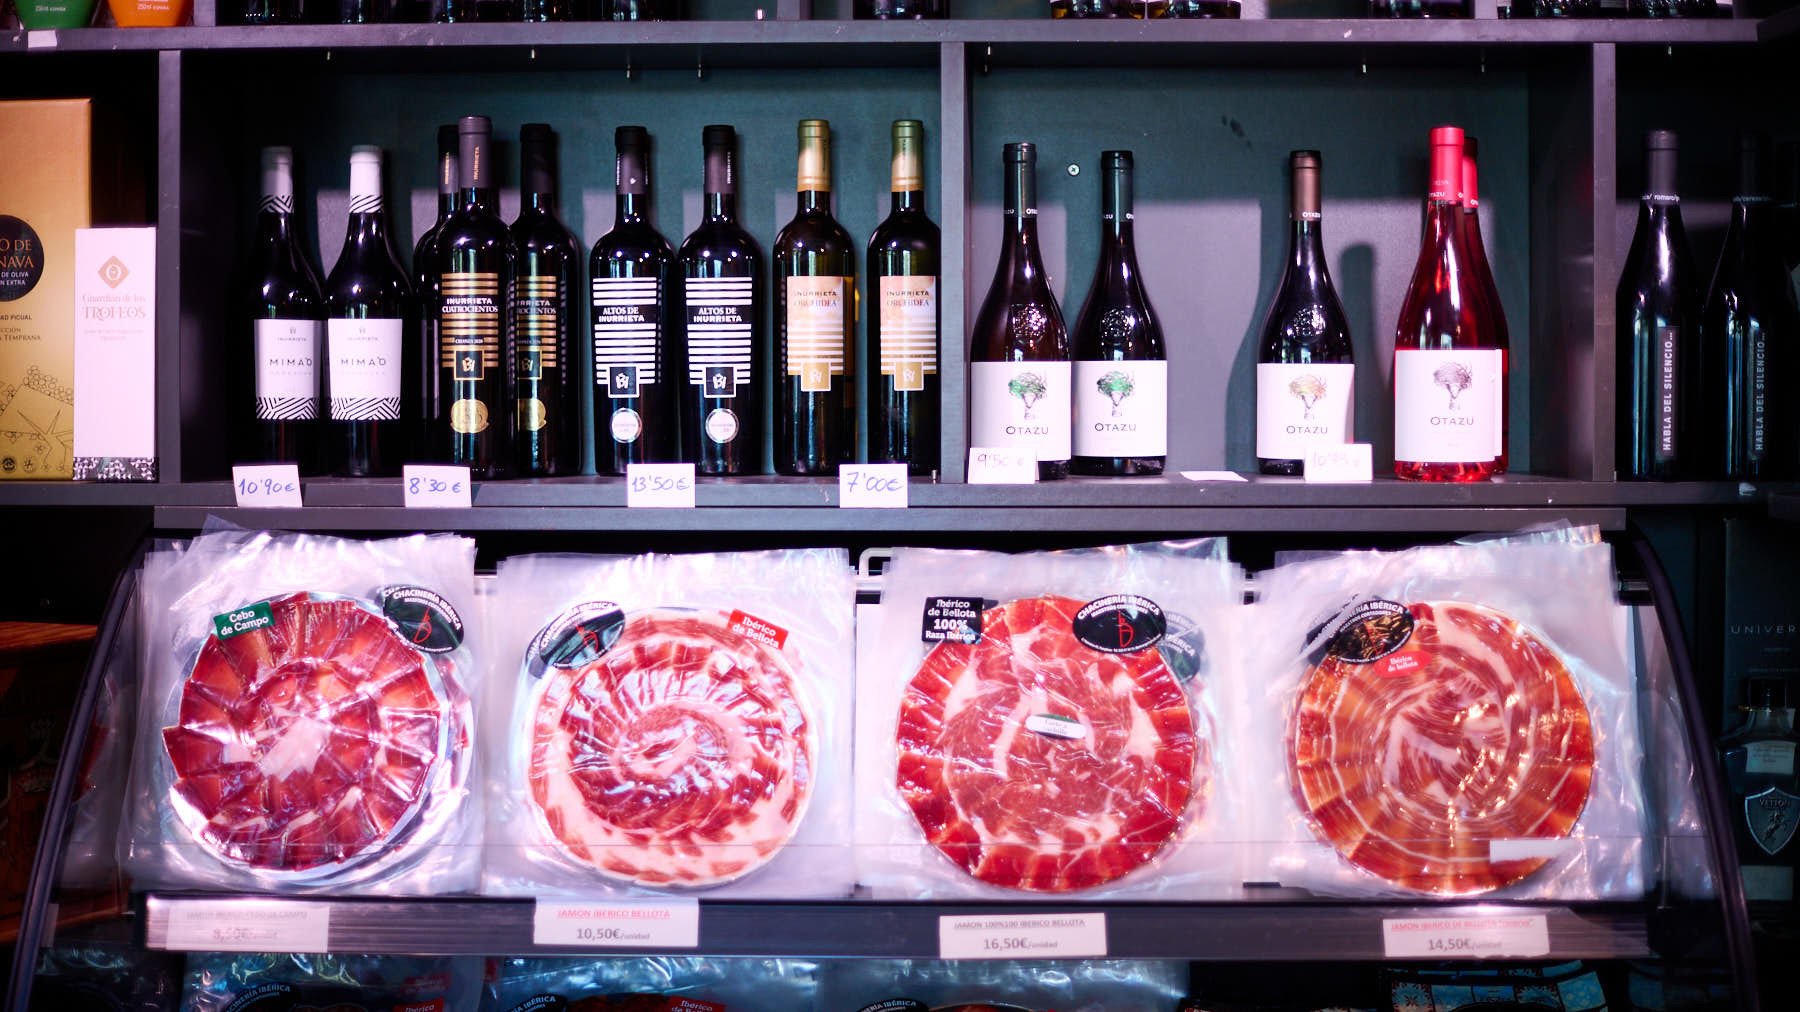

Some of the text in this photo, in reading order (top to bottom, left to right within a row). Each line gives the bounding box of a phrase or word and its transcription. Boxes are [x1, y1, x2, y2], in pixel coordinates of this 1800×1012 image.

[14, 239, 33, 251] DE
[446, 297, 493, 305] INURRIETA
[81, 305, 147, 321] TROFEOS
[441, 305, 498, 314] CUATROCIENTOS
[603, 306, 639, 315] ALTOS DE
[698, 307, 737, 315] ALTOS DE
[598, 315, 645, 323] INURRIETA
[693, 315, 743, 323] INURRIETA
[1663, 393, 1673, 413] DEL
[1756, 393, 1765, 413] DEL
[1429, 416, 1474, 427] OTAZU
[1005, 425, 1049, 436] OTAZU
[1094, 422, 1137, 433] OTAZU
[1285, 425, 1329, 435] OTAZU
[1662, 416, 1673, 451] HABLA
[1755, 416, 1764, 451] HABLA
[936, 599, 971, 608] Ibérico
[1077, 595, 1161, 620] CHACINERÍA IBÉRICA
[1370, 601, 1404, 615] IBÉRICA
[228, 610, 256, 623] Cebo
[927, 607, 977, 618] de Bellota
[220, 616, 270, 636] de Campo
[742, 616, 777, 637] Ibérico
[933, 618, 969, 631] 100%
[732, 623, 780, 649] de Bellota
[925, 630, 946, 639] Raza
[558, 909, 671, 919] JAMON IBERICO BELLOTA
[954, 922, 982, 930] JAMON
[1020, 920, 1050, 929] IBERICO
[1051, 919, 1086, 928] BELLOTA
[1391, 922, 1419, 931] JAMON
